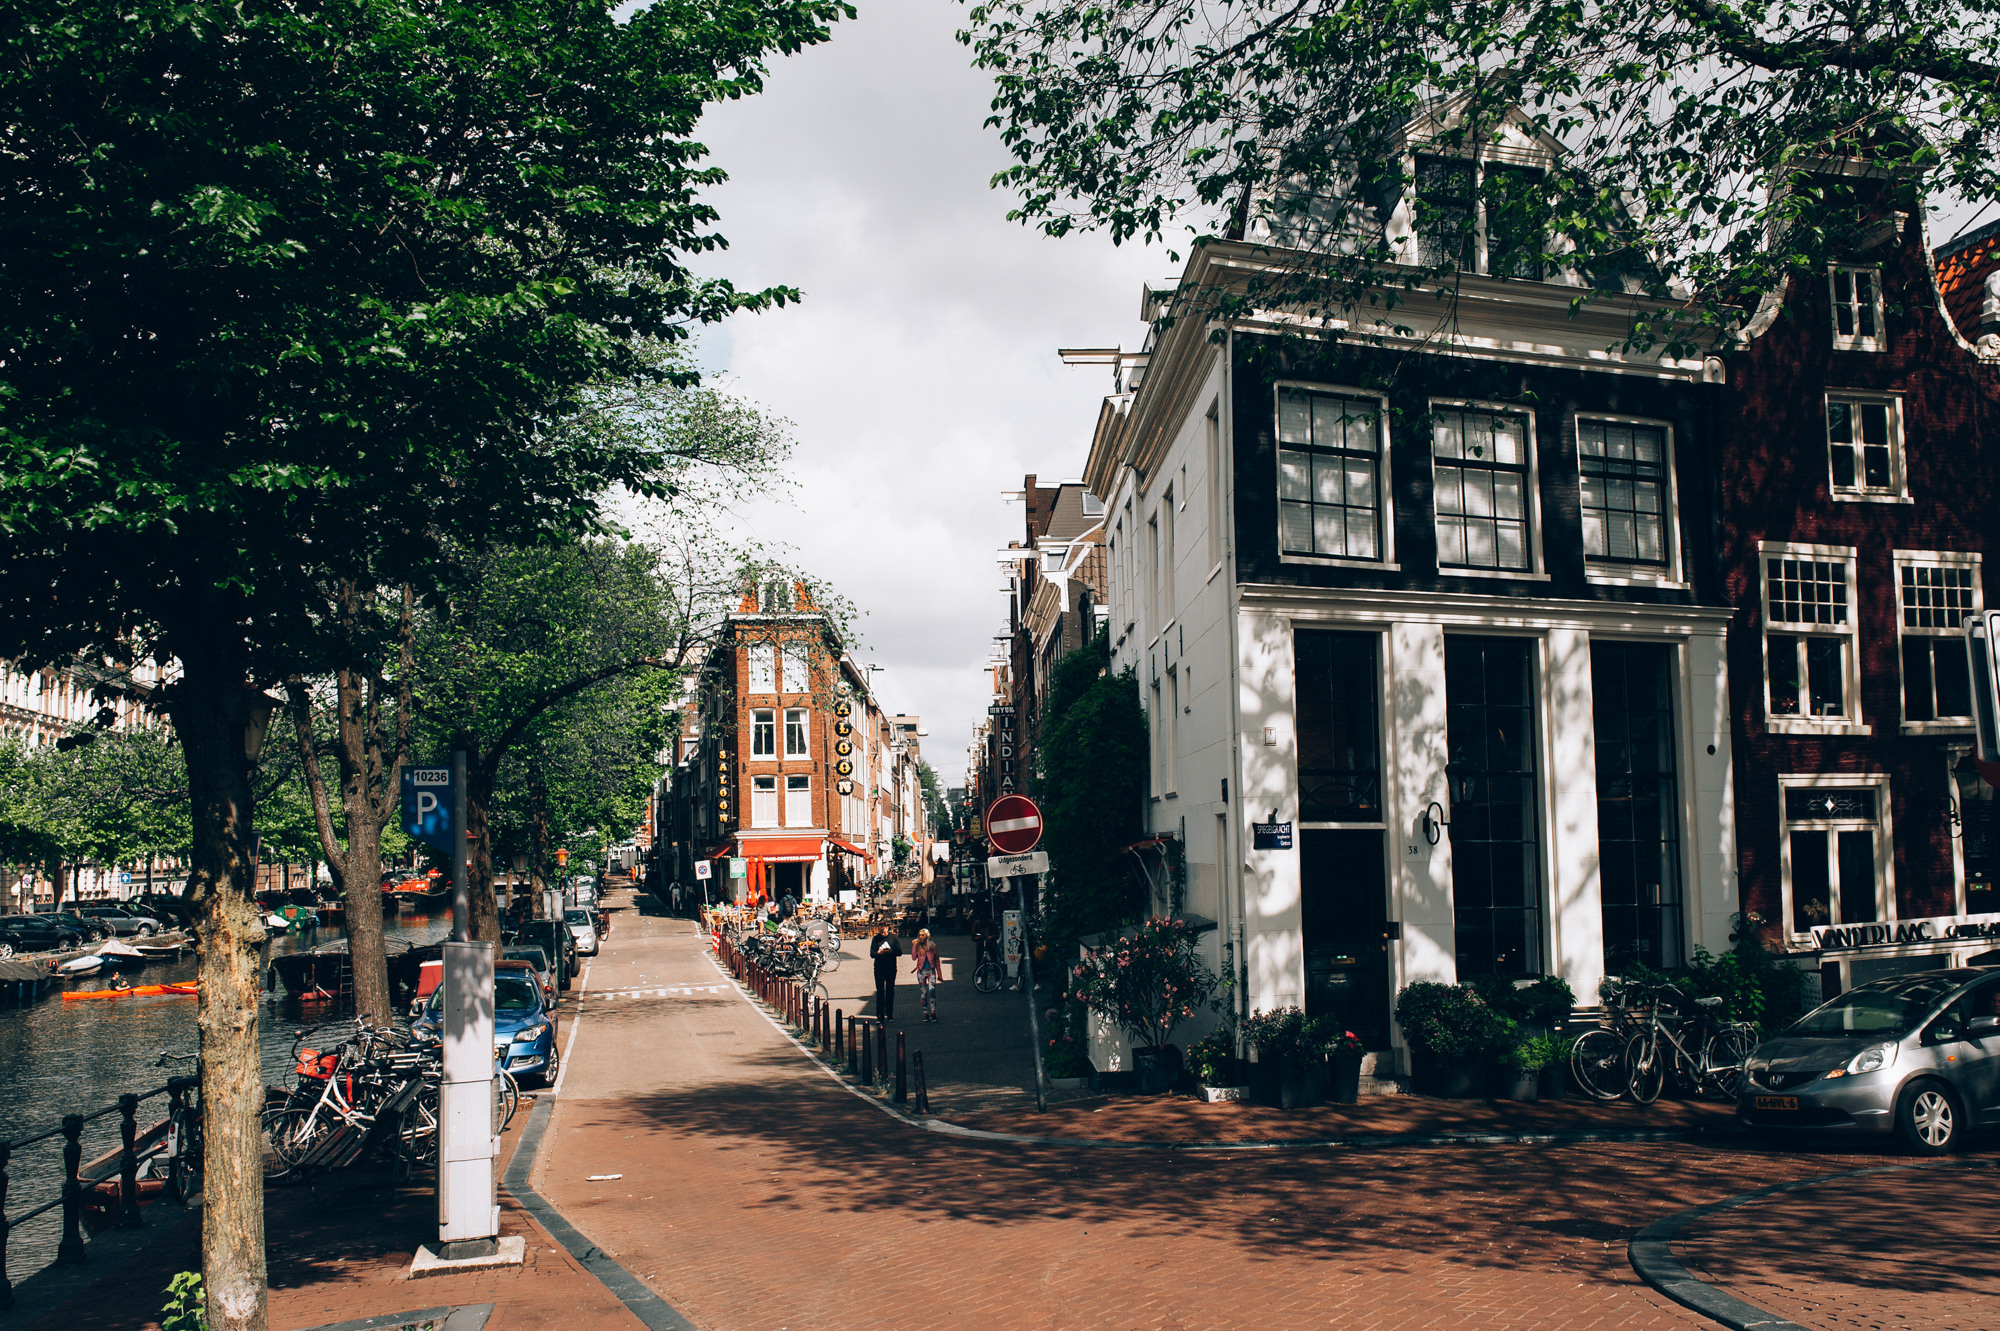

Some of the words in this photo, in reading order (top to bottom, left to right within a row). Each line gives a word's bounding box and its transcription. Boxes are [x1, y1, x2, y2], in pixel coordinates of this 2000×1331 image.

[836, 685, 852, 793] SALOON
[414, 771, 447, 782] 10236
[718, 749, 728, 823] SALOON
[417, 791, 438, 825] P
[998, 854, 1033, 864] Uitgezonderd
[1408, 845, 1418, 855] 38
